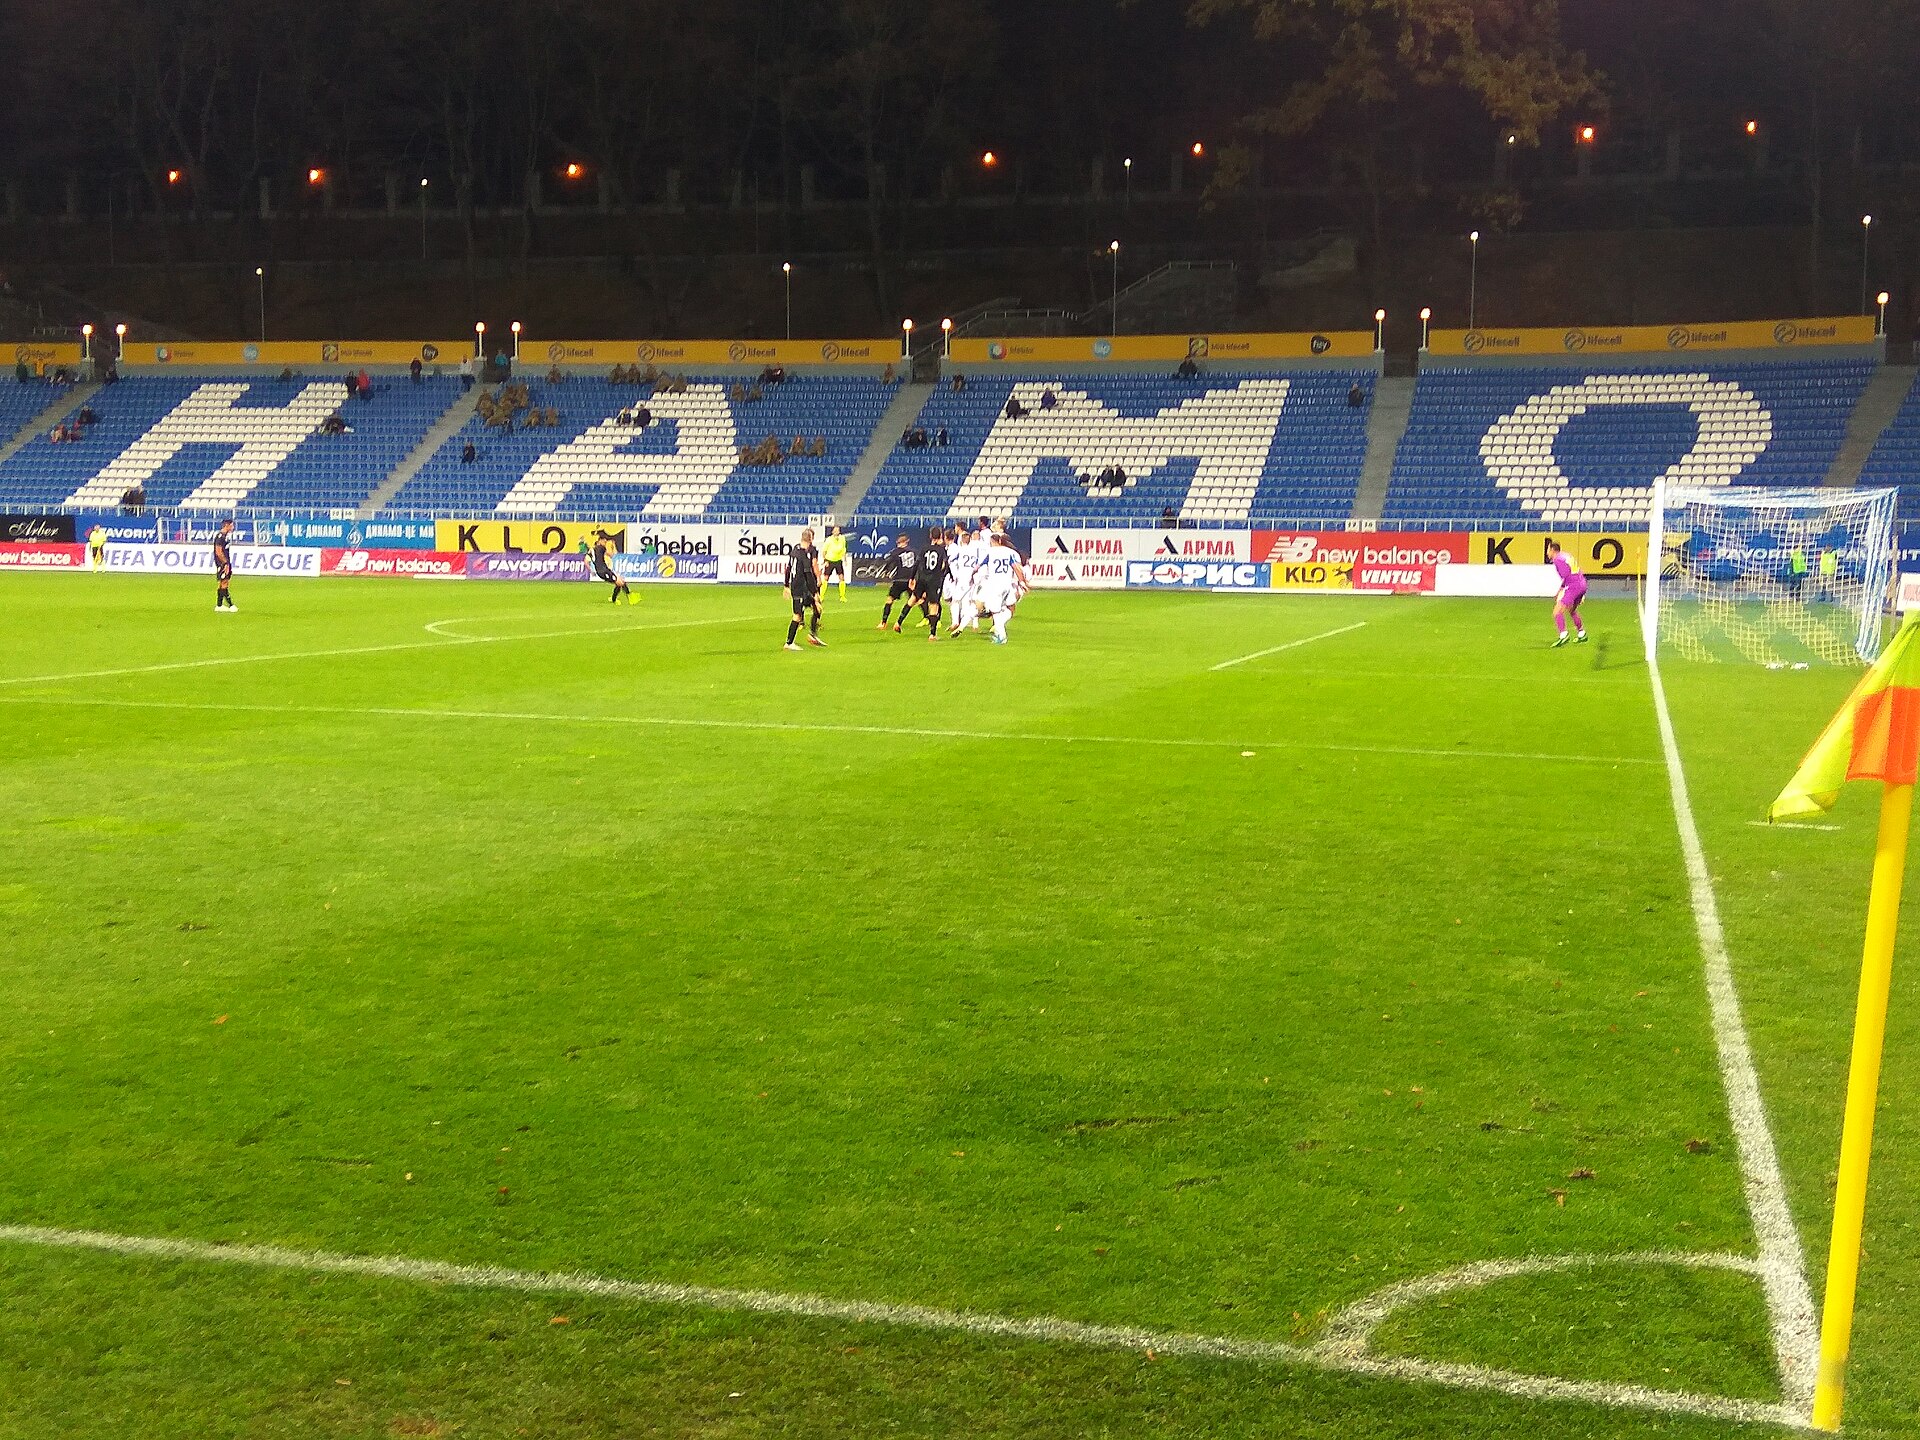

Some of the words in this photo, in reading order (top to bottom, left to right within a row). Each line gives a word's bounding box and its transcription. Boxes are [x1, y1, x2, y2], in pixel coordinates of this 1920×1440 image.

[0, 553, 19, 563] ew
[21, 550, 71, 565] balance
[231, 553, 313, 570] LEAGUE
[1316, 549, 1359, 564] new
[1363, 545, 1451, 564] balance
[367, 559, 395, 571] new
[396, 557, 451, 573] balance
[489, 560, 557, 572] FAVORIT
[679, 560, 717, 574] lifecell
[993, 559, 1009, 573] 25
[1129, 564, 1256, 586] БОРИС
[1285, 567, 1327, 583] KLO
[1361, 570, 1422, 584] VENTUS
